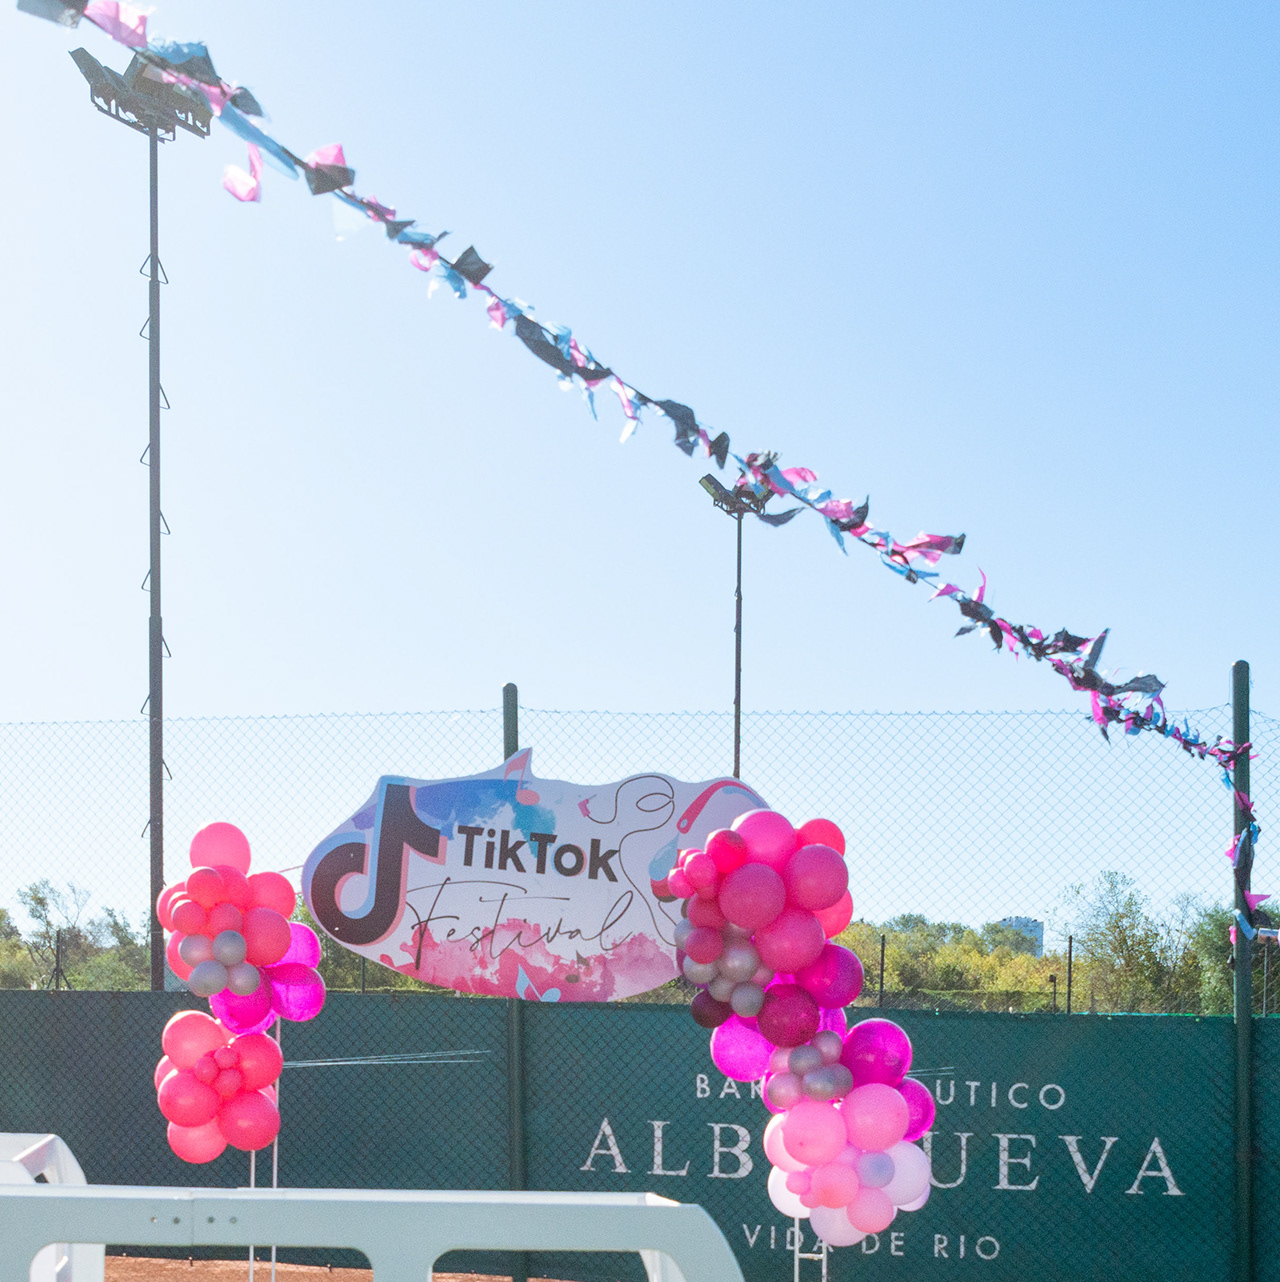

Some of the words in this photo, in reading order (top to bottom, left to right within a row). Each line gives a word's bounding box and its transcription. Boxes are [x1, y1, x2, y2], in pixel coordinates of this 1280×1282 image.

[458, 825, 620, 882] TikTok
[406, 877, 634, 970] Festival
[935, 1079, 1066, 1110] UTICO
[579, 1117, 1186, 1196] ALBUEVA
[861, 1232, 905, 1256] DE
[934, 1234, 1001, 1260] RIO
